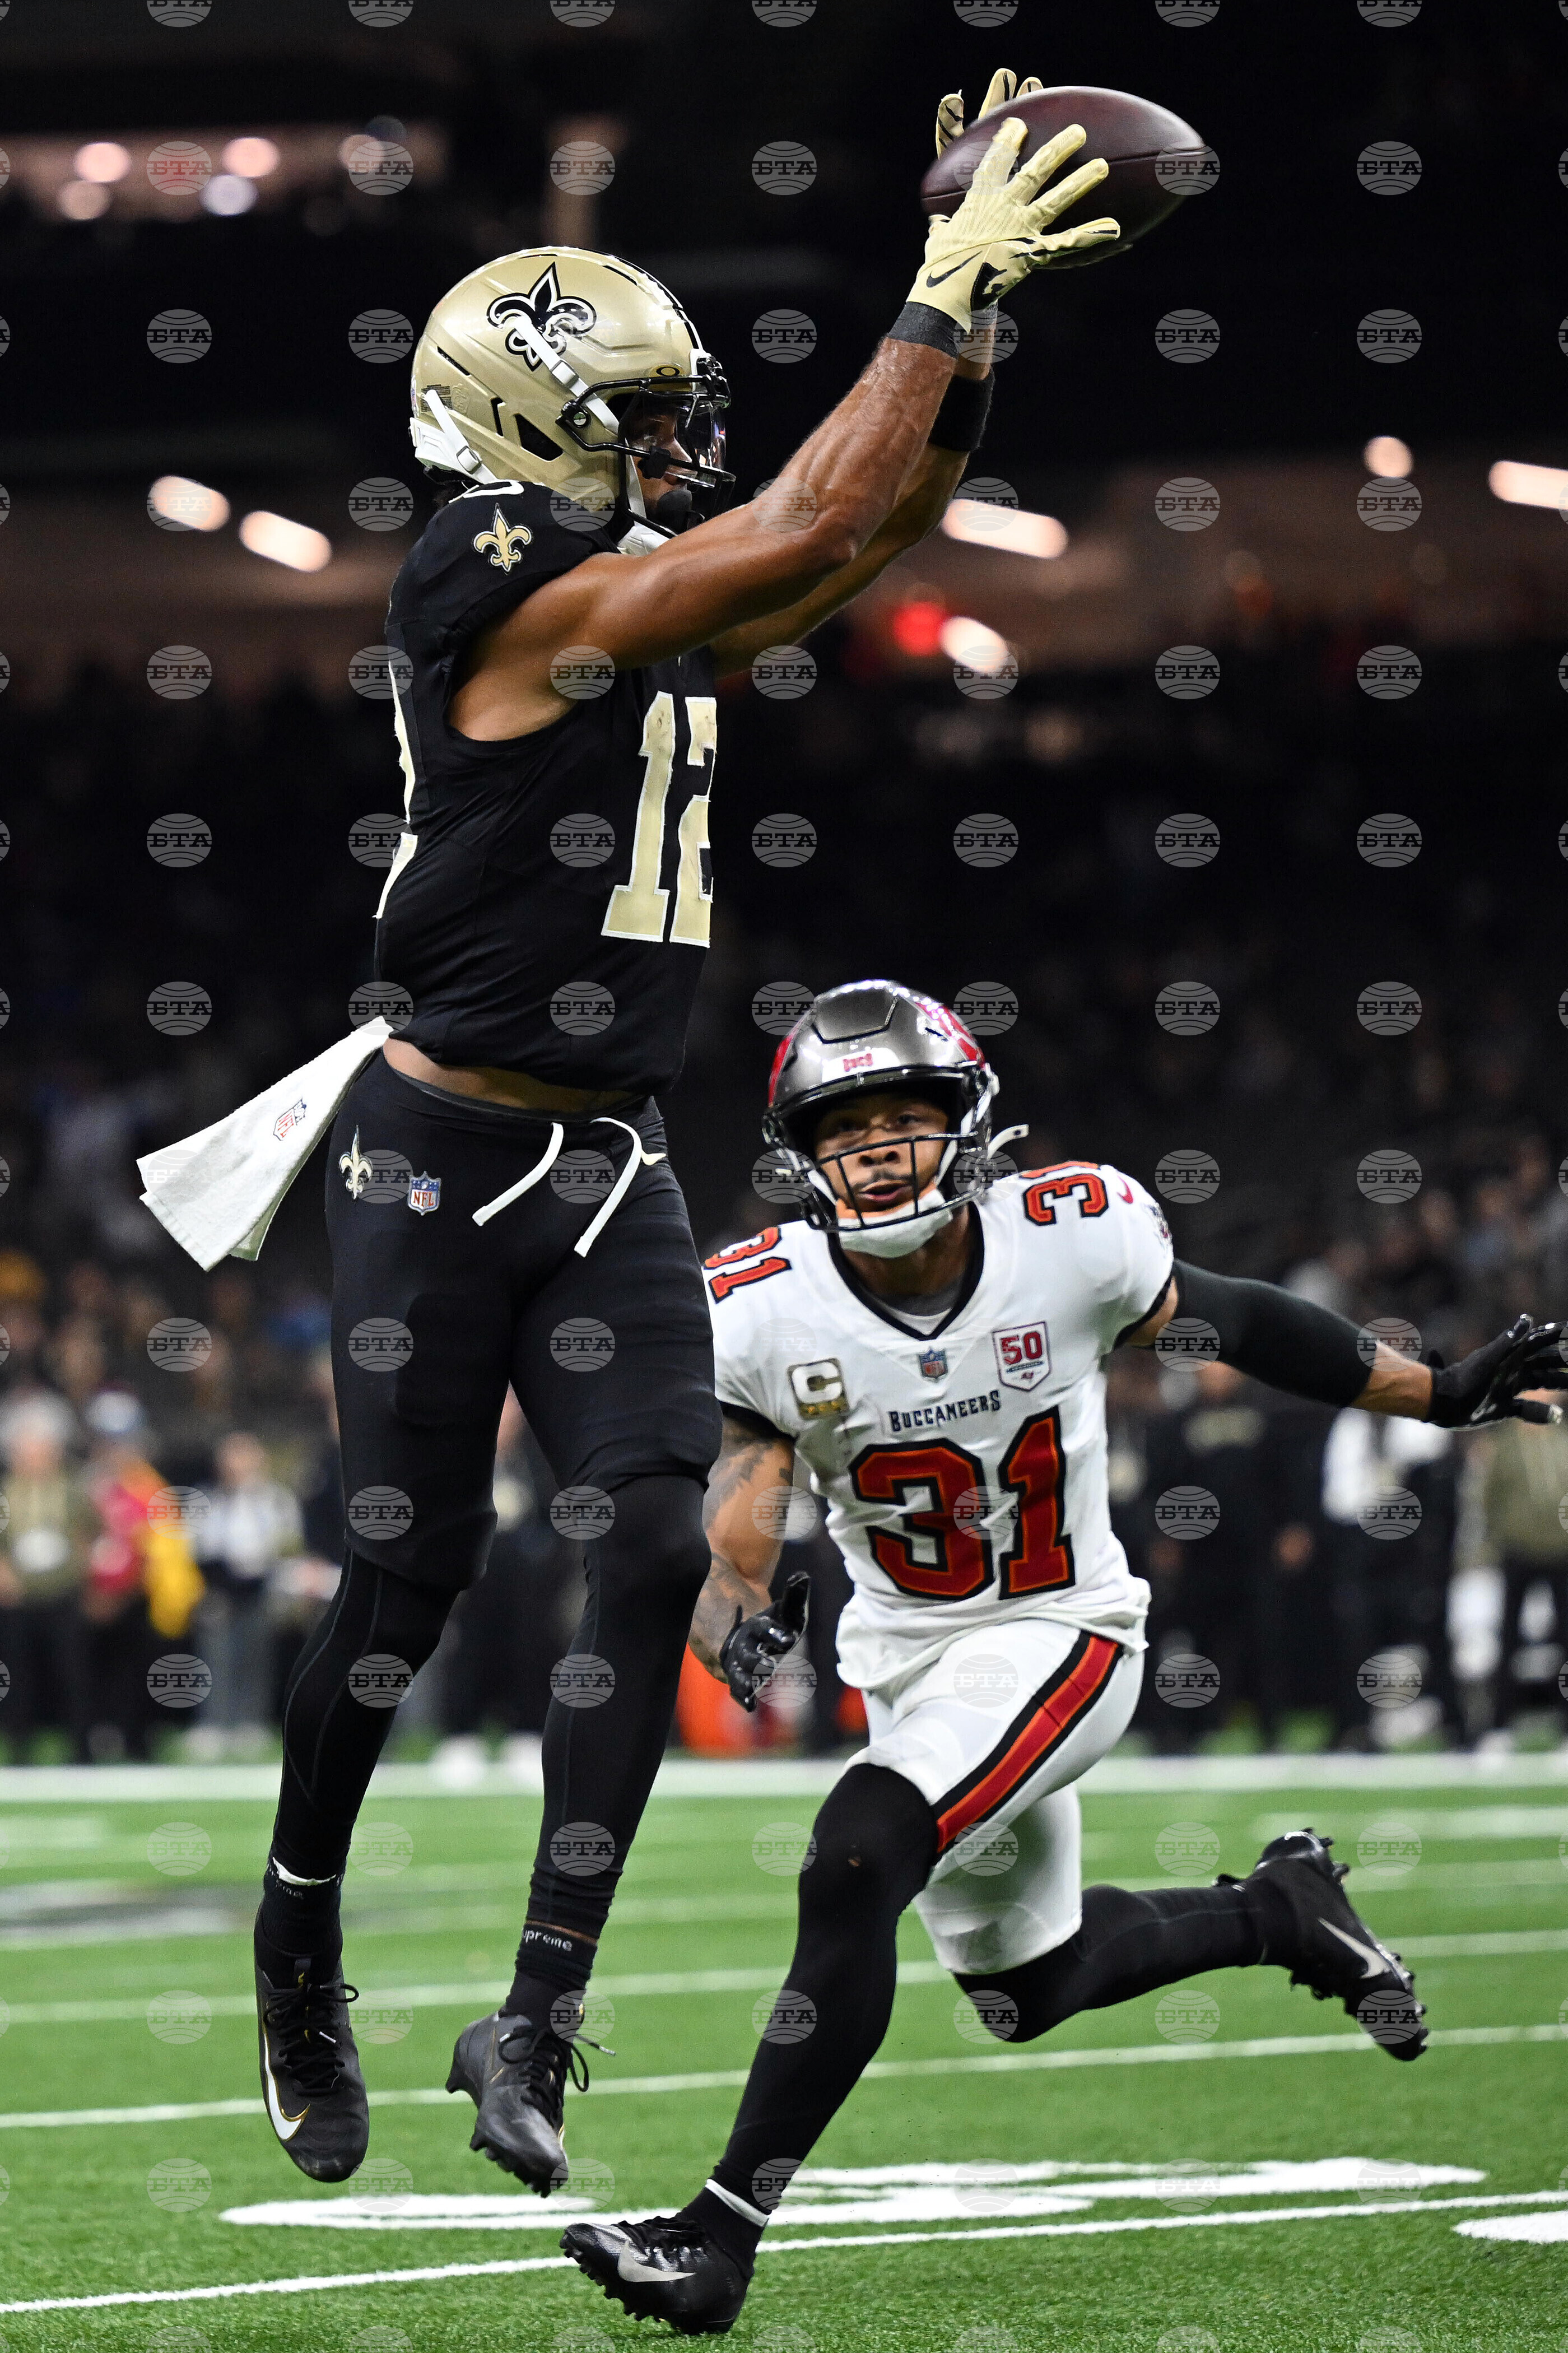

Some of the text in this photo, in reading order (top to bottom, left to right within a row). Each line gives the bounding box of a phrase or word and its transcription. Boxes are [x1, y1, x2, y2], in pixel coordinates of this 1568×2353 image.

[413, 1191, 434, 1207] NFL
[1001, 1331, 1043, 1365] 50
[791, 1361, 843, 1404] C
[888, 1389, 1002, 1432] BUCCANEERS
[848, 1405, 1076, 1601] 31
